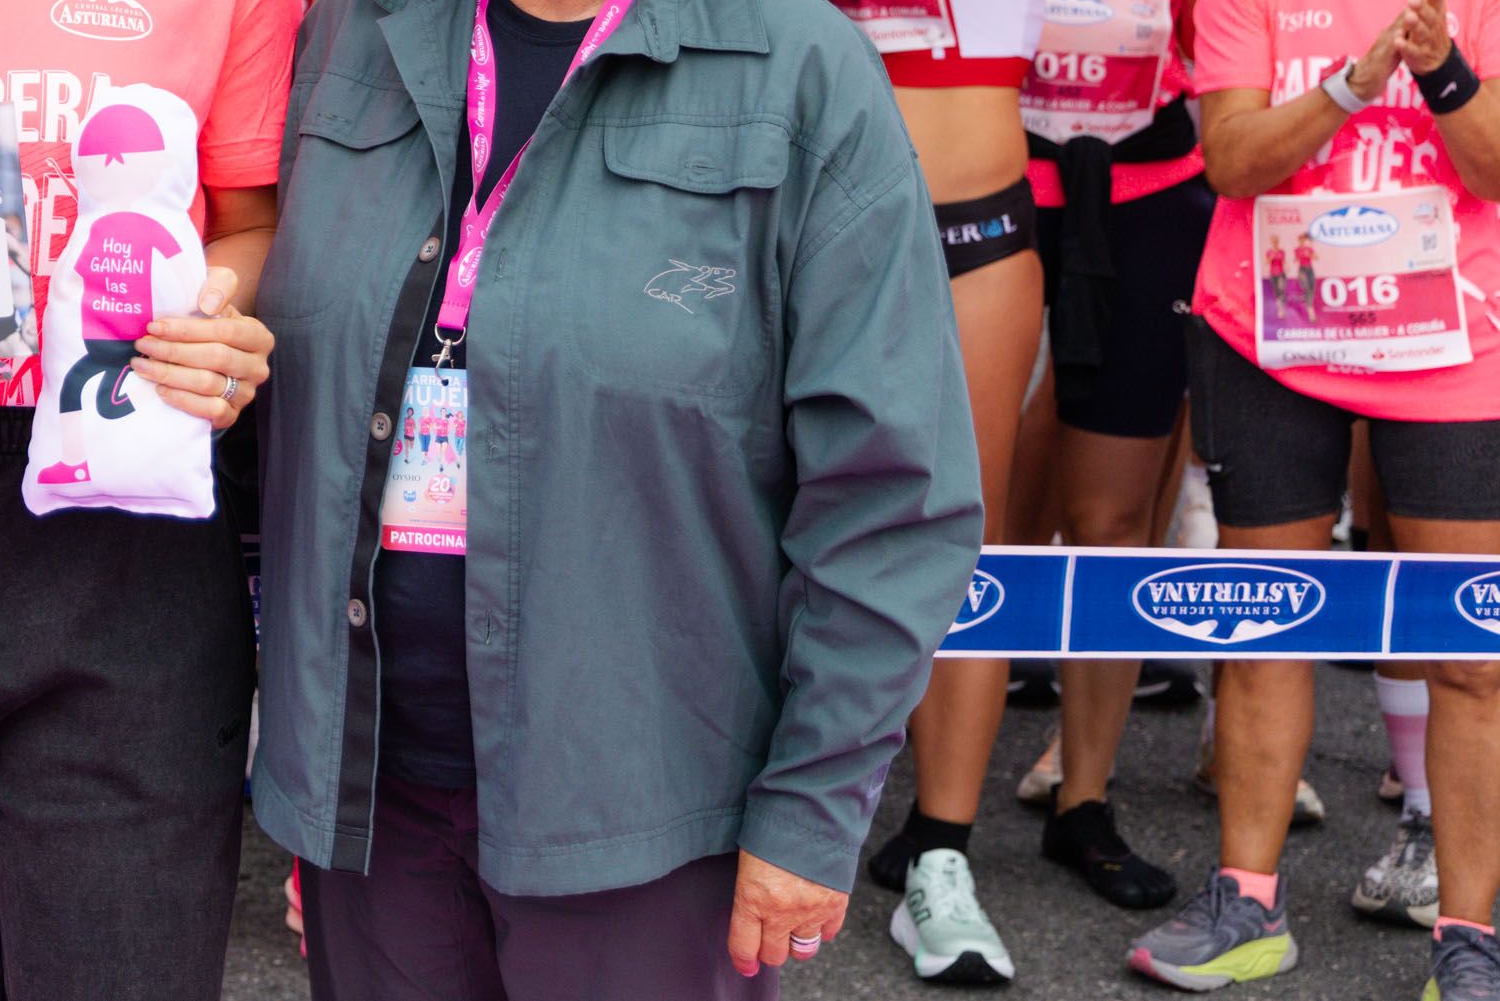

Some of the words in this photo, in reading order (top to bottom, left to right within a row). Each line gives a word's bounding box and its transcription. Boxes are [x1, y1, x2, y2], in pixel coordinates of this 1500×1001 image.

[58, 4, 146, 33] ASTURIANA
[1035, 51, 1108, 83] 016
[1316, 222, 1393, 238] ASTURIANA
[103, 237, 132, 258] Hoy
[90, 256, 144, 275] GANAN
[105, 276, 128, 294] las
[1321, 275, 1400, 307] 016
[92, 295, 142, 314] chicas
[403, 385, 468, 408] MUJE
[392, 472, 421, 482] OYSHO
[430, 476, 451, 492] 20
[390, 530, 468, 548] PATROCINA
[1148, 581, 1312, 614] ASTURIANA
[1152, 605, 1214, 616] LECHERA
[1219, 606, 1281, 616] CENTRAL
